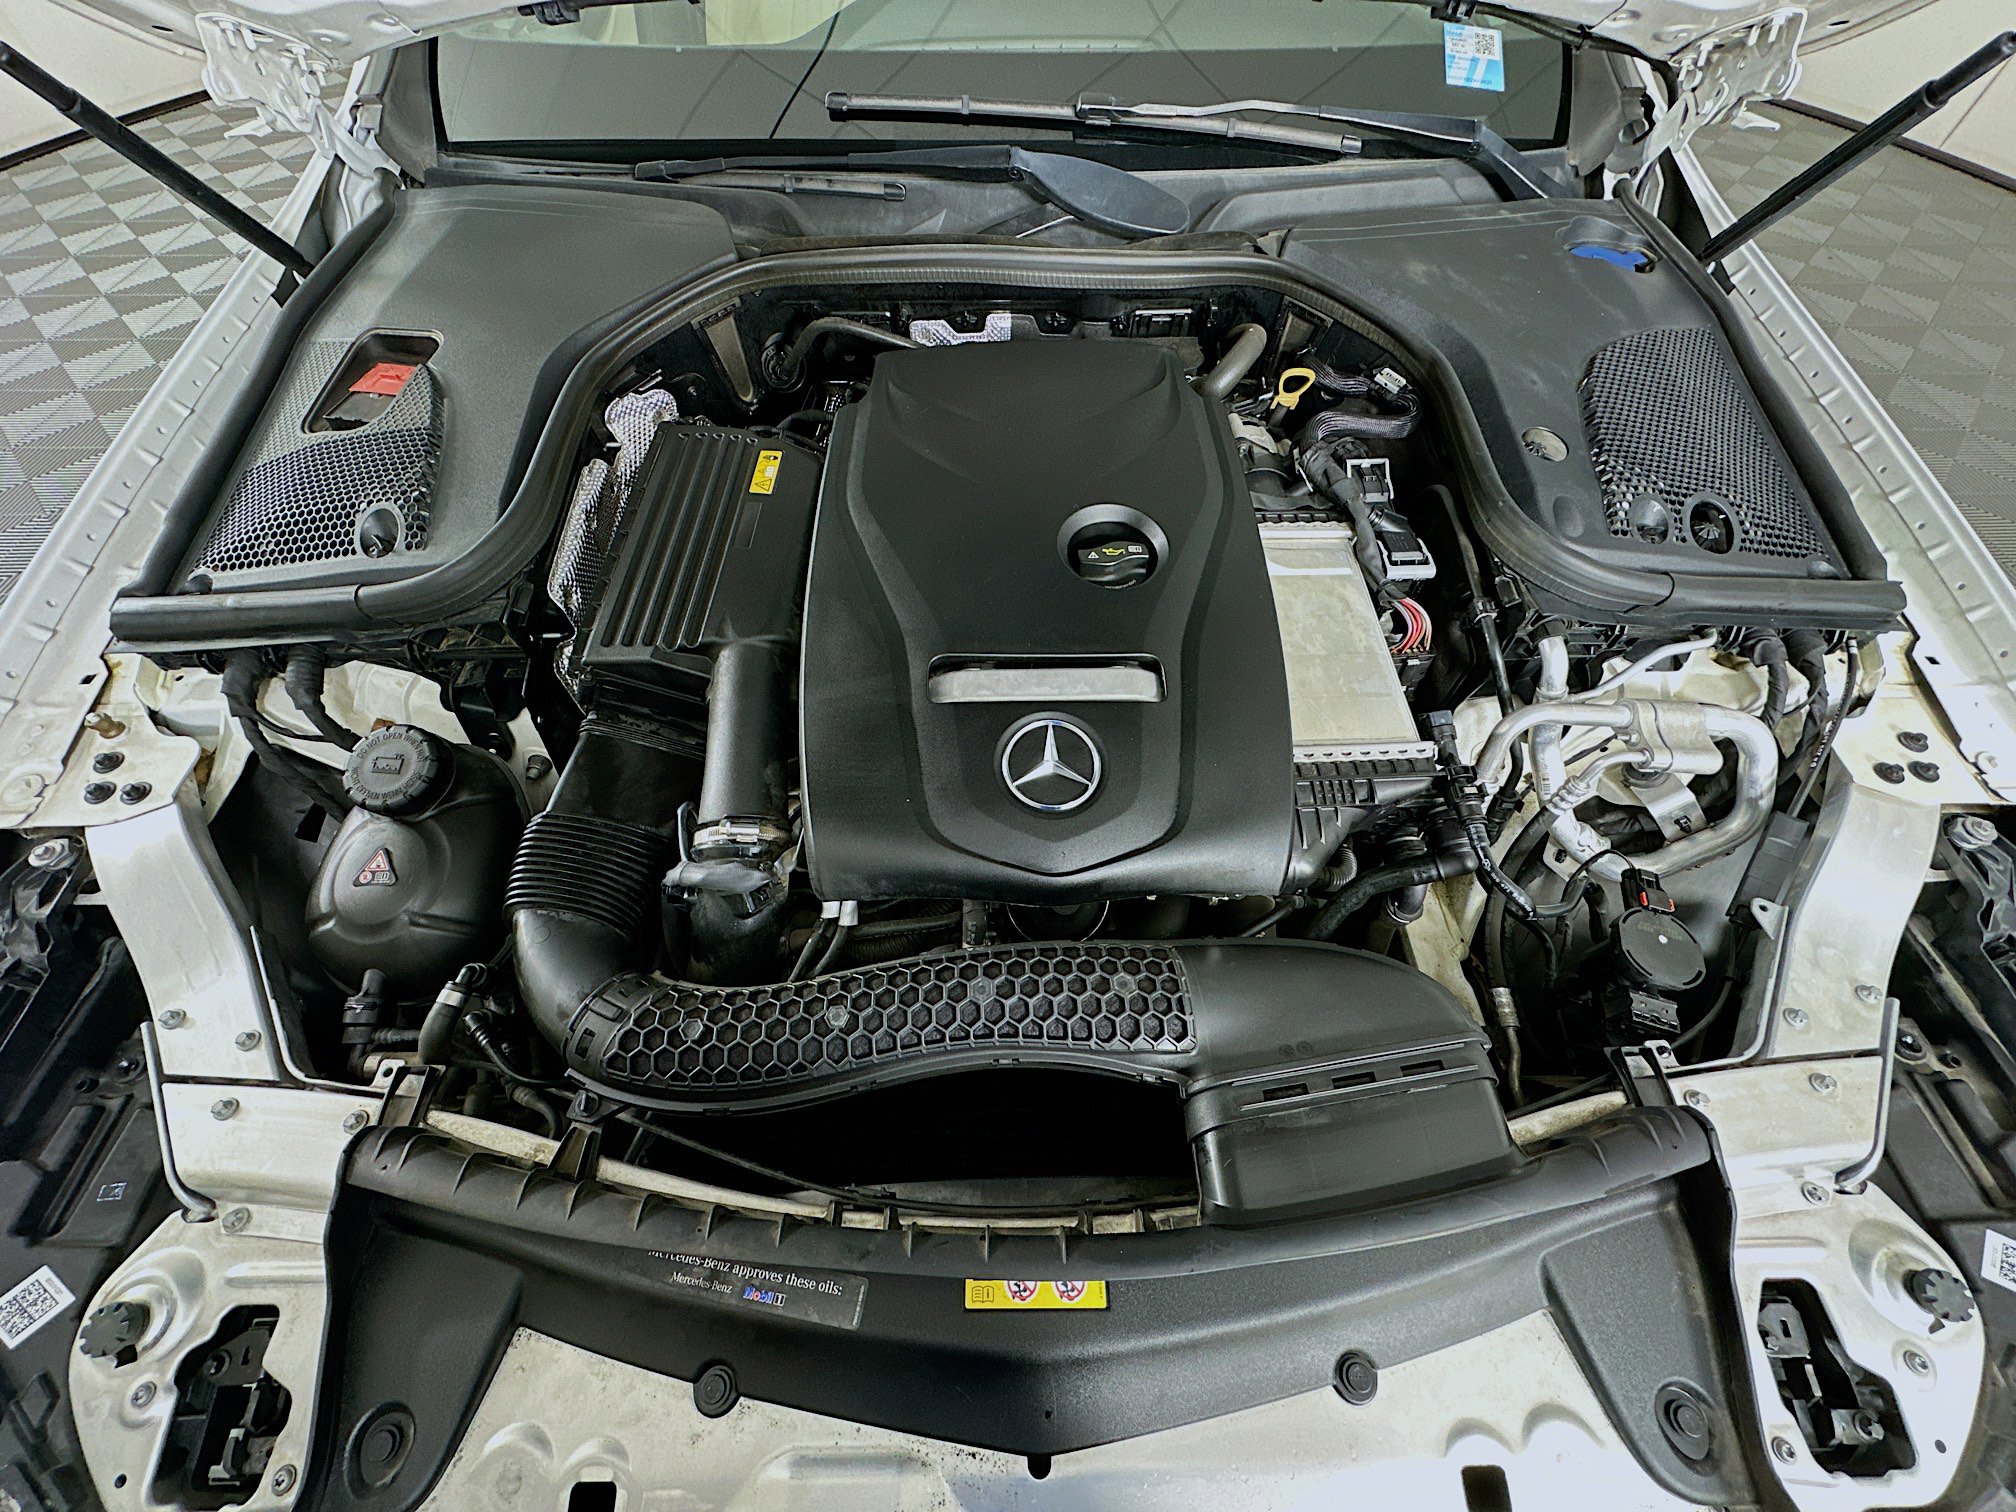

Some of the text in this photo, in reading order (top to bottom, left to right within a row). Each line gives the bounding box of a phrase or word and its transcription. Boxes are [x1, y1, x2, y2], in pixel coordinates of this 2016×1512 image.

[356, 732, 424, 762] DO NOT OPEN WHEN HOT
[670, 1271, 733, 1294] Mercedes-Benz
[742, 1286, 775, 1305] Mobil
[732, 1264, 784, 1283] approves
[785, 1273, 816, 1290] these
[818, 1280, 843, 1296] oils:
